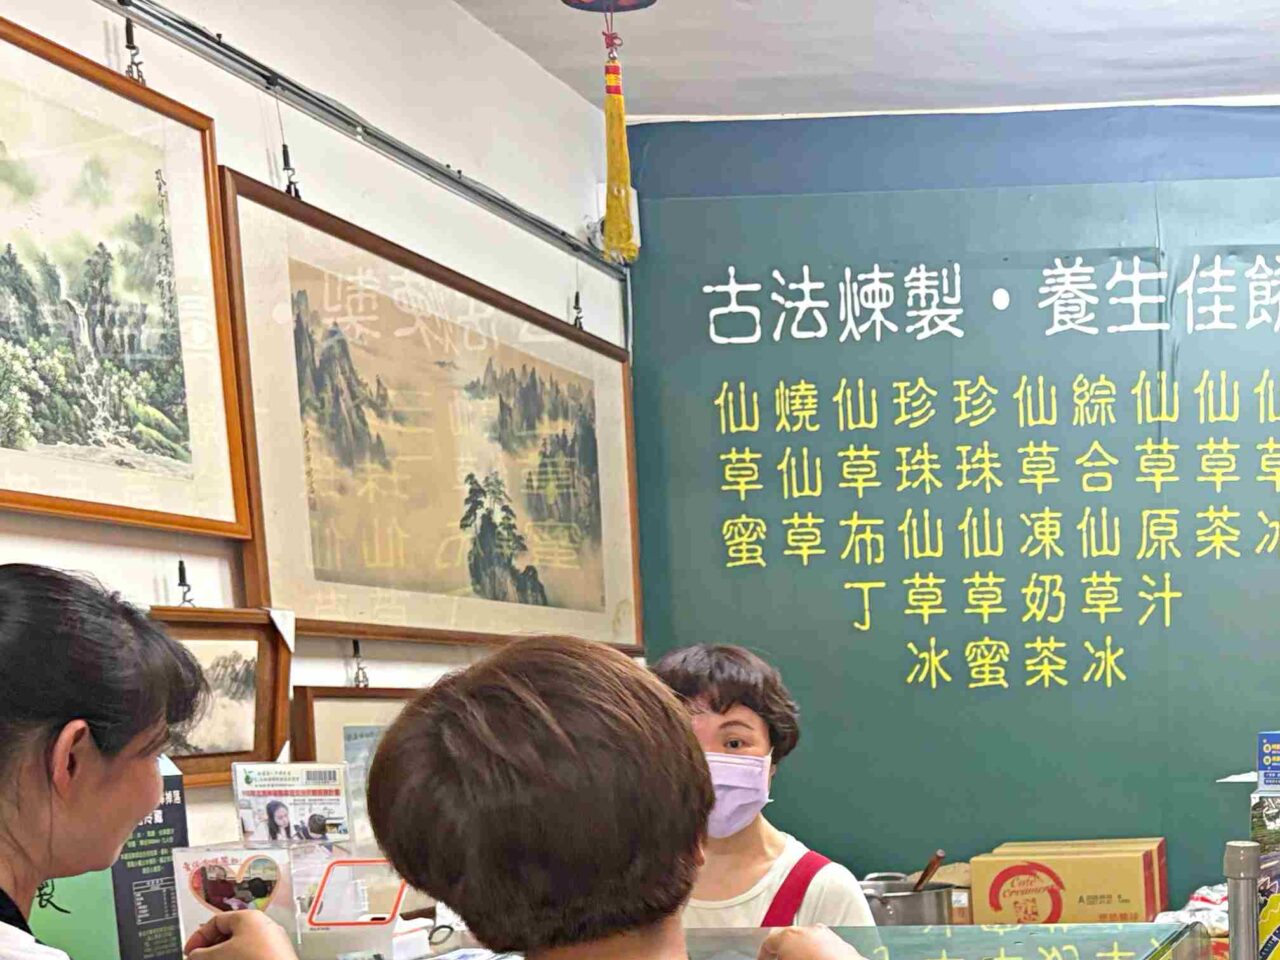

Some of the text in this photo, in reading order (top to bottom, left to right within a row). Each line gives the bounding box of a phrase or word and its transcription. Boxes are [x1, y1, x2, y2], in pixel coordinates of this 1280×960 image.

[714, 381, 767, 567] 仙草蜜
[775, 379, 826, 566] 燒仙草
[832, 378, 885, 631] 仙草布丁
[892, 377, 950, 688] 珍珠仙草冰
[952, 375, 1010, 689] 珍珠仙草蜜
[1071, 374, 1127, 688] 綜合仙草冰
[1131, 370, 1183, 628] 仙草原汁
[1192, 370, 1242, 560] 仙草茶
